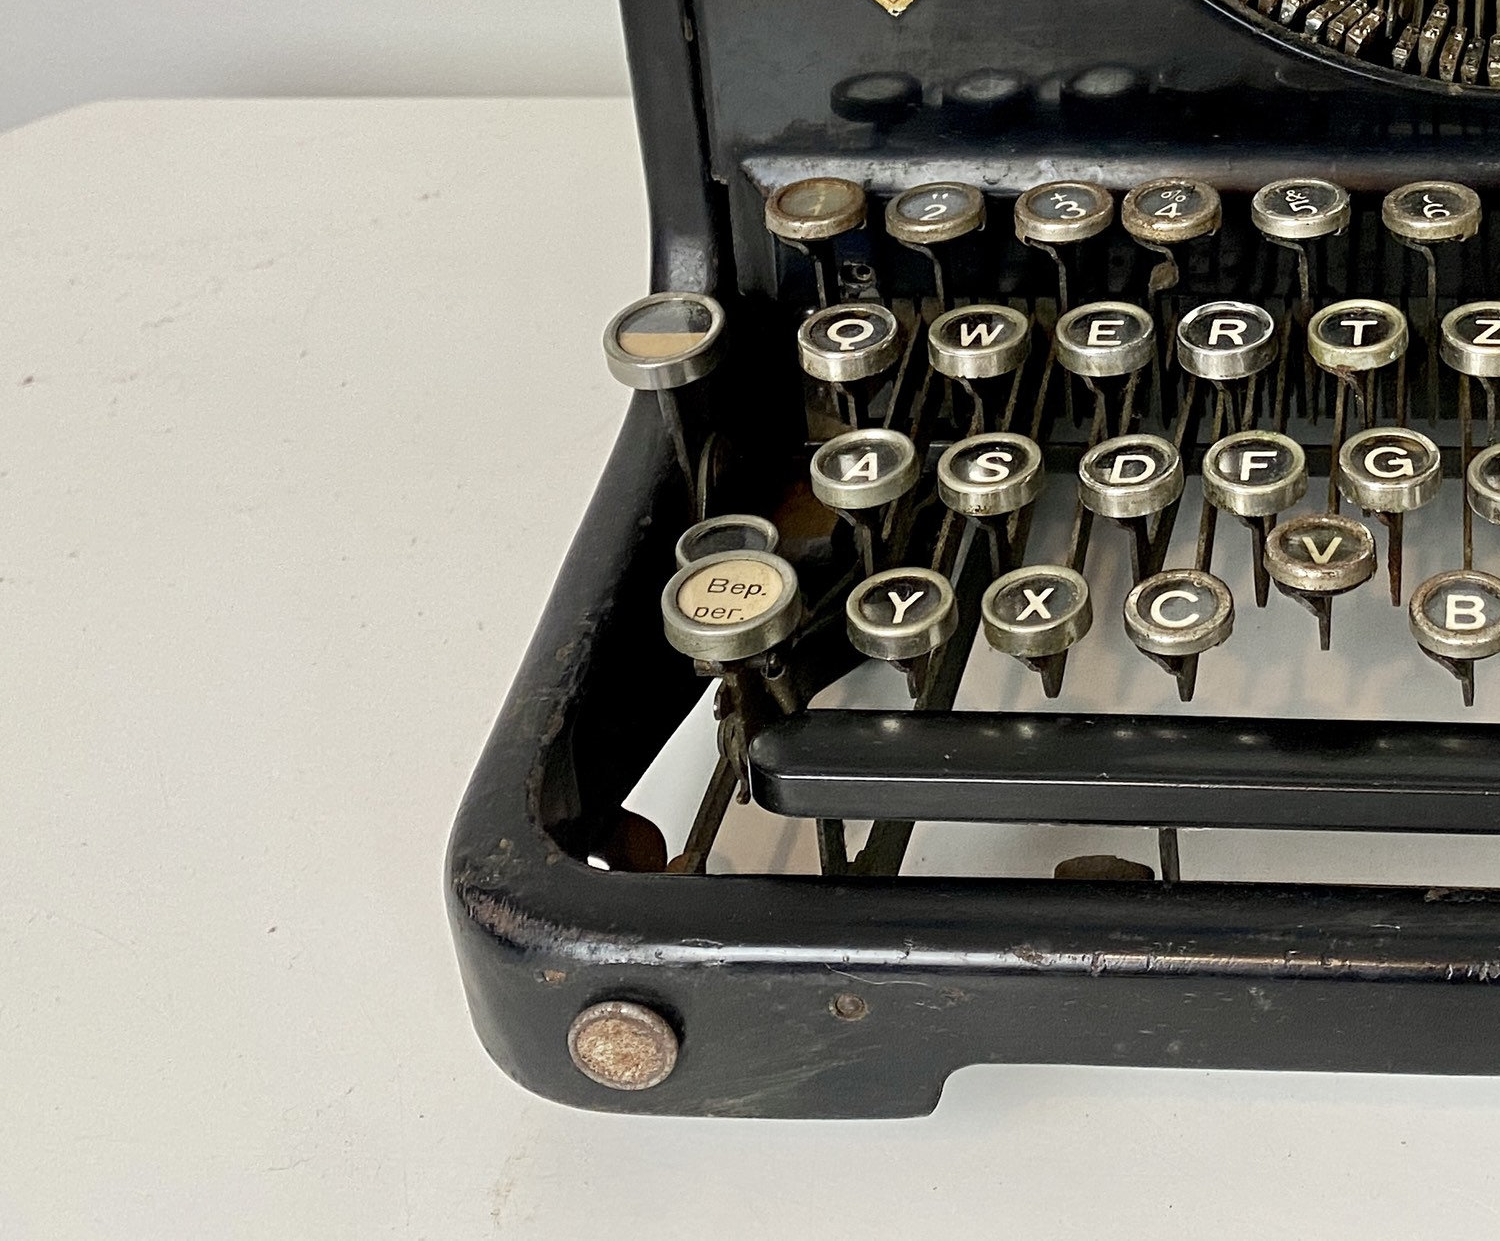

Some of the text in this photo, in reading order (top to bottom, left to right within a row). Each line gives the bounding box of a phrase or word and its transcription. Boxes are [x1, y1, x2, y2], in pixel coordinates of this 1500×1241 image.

[1054, 201, 1087, 219] 3
[1153, 202, 1182, 218] 4
[826, 318, 875, 350] Q
[959, 322, 1004, 347] W
[1087, 320, 1125, 346] E
[1208, 319, 1248, 346] R
[1340, 319, 1378, 346] T
[840, 452, 879, 481] A
[968, 451, 1014, 483] S
[1108, 454, 1156, 485] D
[1239, 450, 1278, 481] F
[1364, 446, 1415, 479] G
[1301, 536, 1343, 565] V
[887, 590, 925, 625] Y
[1015, 587, 1056, 622] X
[1149, 589, 1200, 629] C
[1444, 593, 1487, 631] B
